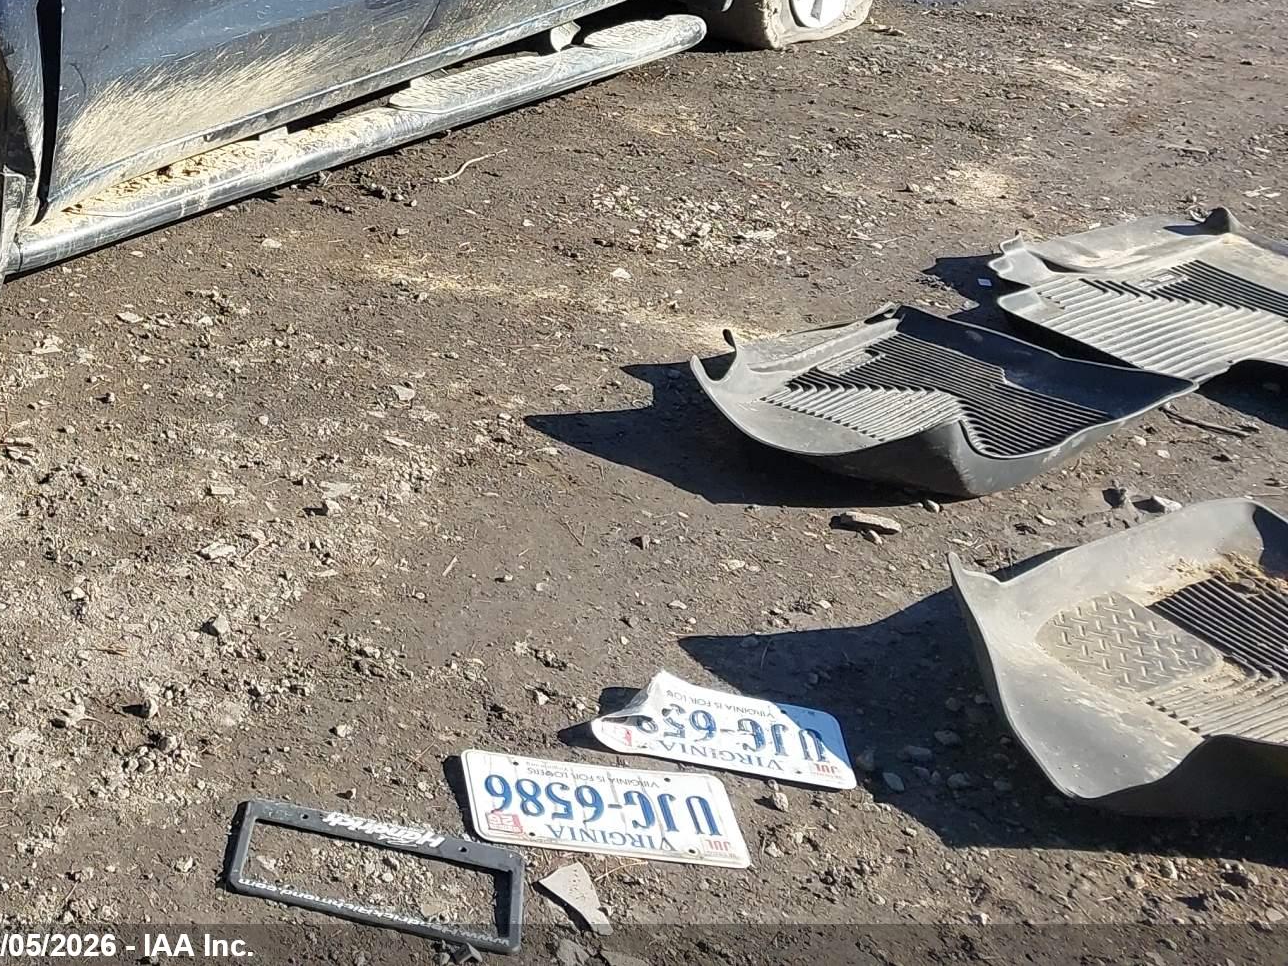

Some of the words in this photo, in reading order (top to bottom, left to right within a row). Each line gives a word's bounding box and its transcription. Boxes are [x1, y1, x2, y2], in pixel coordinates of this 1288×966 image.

[659, 739, 784, 771] VIRGINIA
[815, 763, 839, 774] JUL
[484, 774, 722, 836] UJG-6586
[547, 824, 678, 851] VIRGINIA
[705, 839, 731, 851] JUL
